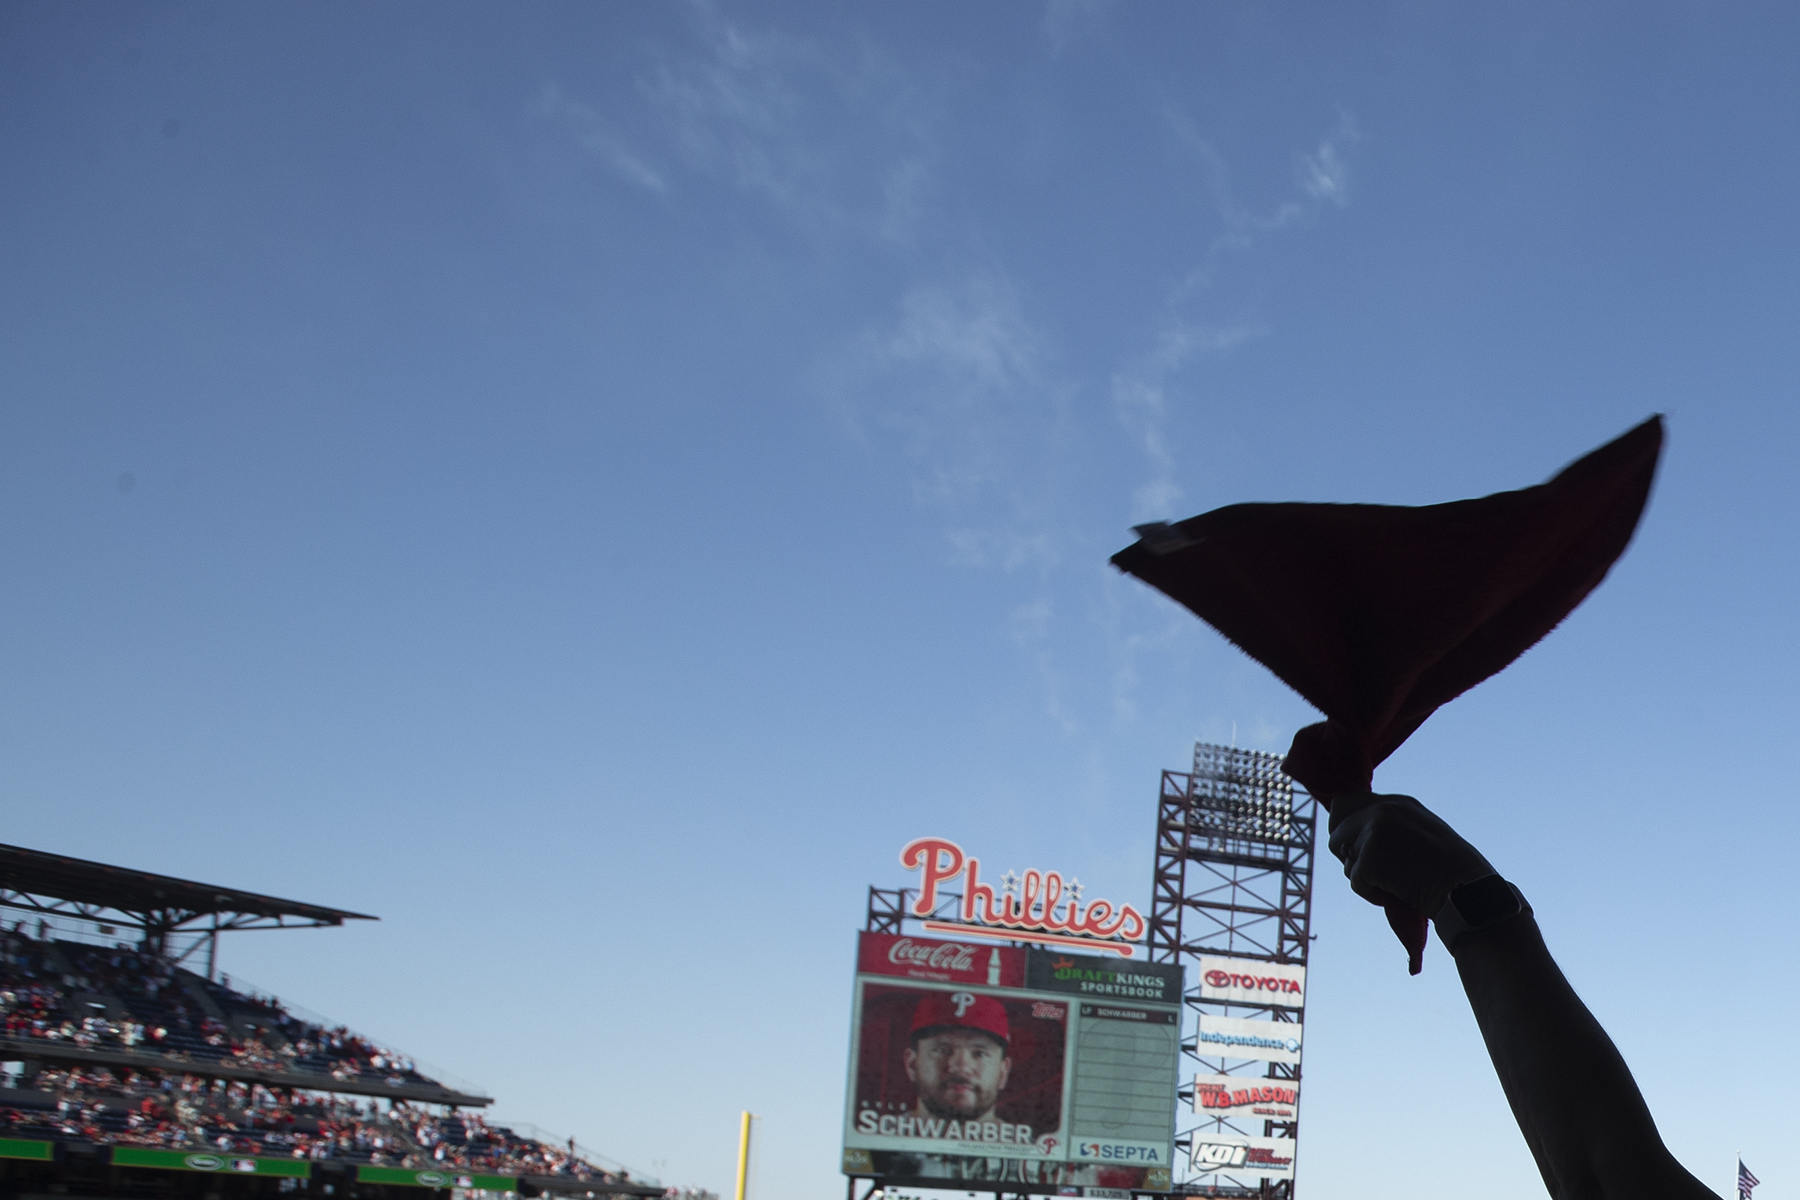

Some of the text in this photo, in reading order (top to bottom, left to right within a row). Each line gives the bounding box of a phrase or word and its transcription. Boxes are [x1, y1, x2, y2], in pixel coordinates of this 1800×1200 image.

[899, 837, 1146, 941] Phillies
[1054, 966, 1165, 988] DRAFTKINGS
[1229, 973, 1302, 995] TOYOTA
[1080, 981, 1164, 999] SPORTSBOOK
[1097, 1008, 1148, 1020] SCHWARBER
[1200, 1031, 1285, 1050] Independence
[858, 1109, 1034, 1146] SCHWARBER
[1101, 1145, 1158, 1161] SEPTA
[1195, 1143, 1247, 1166] KDI
